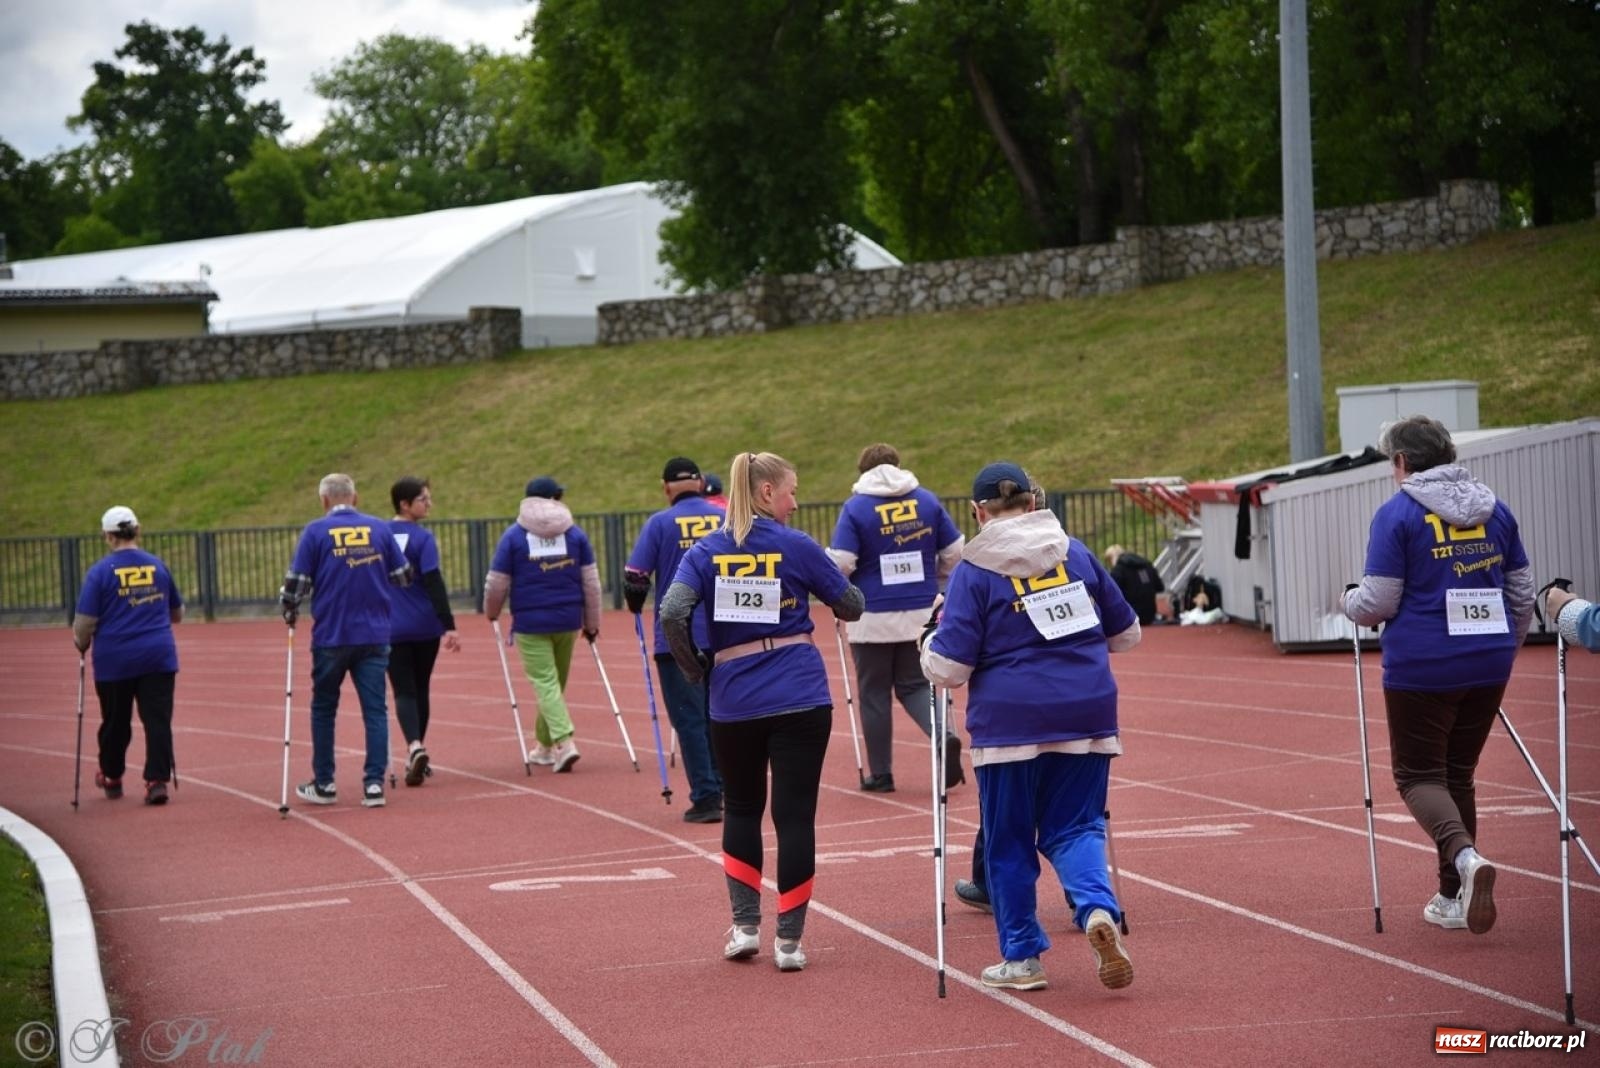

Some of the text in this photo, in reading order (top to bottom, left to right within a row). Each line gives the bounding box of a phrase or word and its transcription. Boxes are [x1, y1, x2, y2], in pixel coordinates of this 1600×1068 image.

[875, 499, 919, 525] T2T
[328, 526, 371, 547] T2T
[1432, 543, 1495, 559] T2T SYSTEM
[114, 565, 156, 587] T2T
[894, 563, 911, 574] 151
[734, 592, 763, 608] 123
[1045, 602, 1074, 622] 131
[1461, 604, 1491, 620] 135
